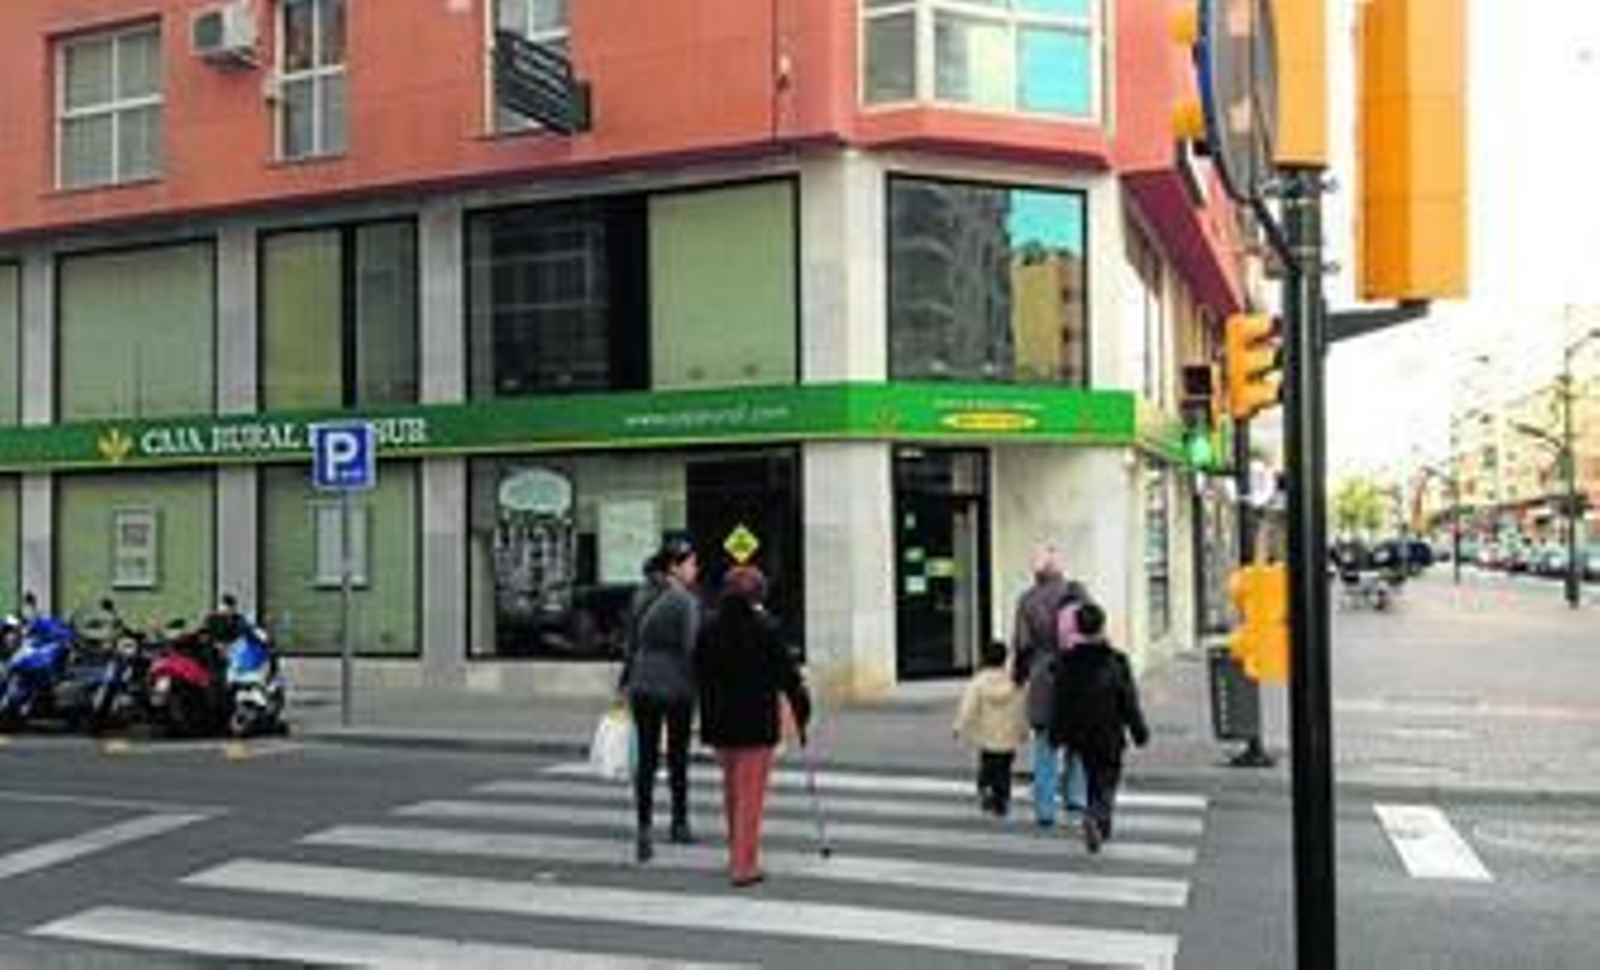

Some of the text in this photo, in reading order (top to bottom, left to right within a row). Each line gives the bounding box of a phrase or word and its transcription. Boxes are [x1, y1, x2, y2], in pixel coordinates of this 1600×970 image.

[141, 427, 204, 453] CAJA
[211, 422, 301, 452] RURAL
[326, 431, 358, 481] P
